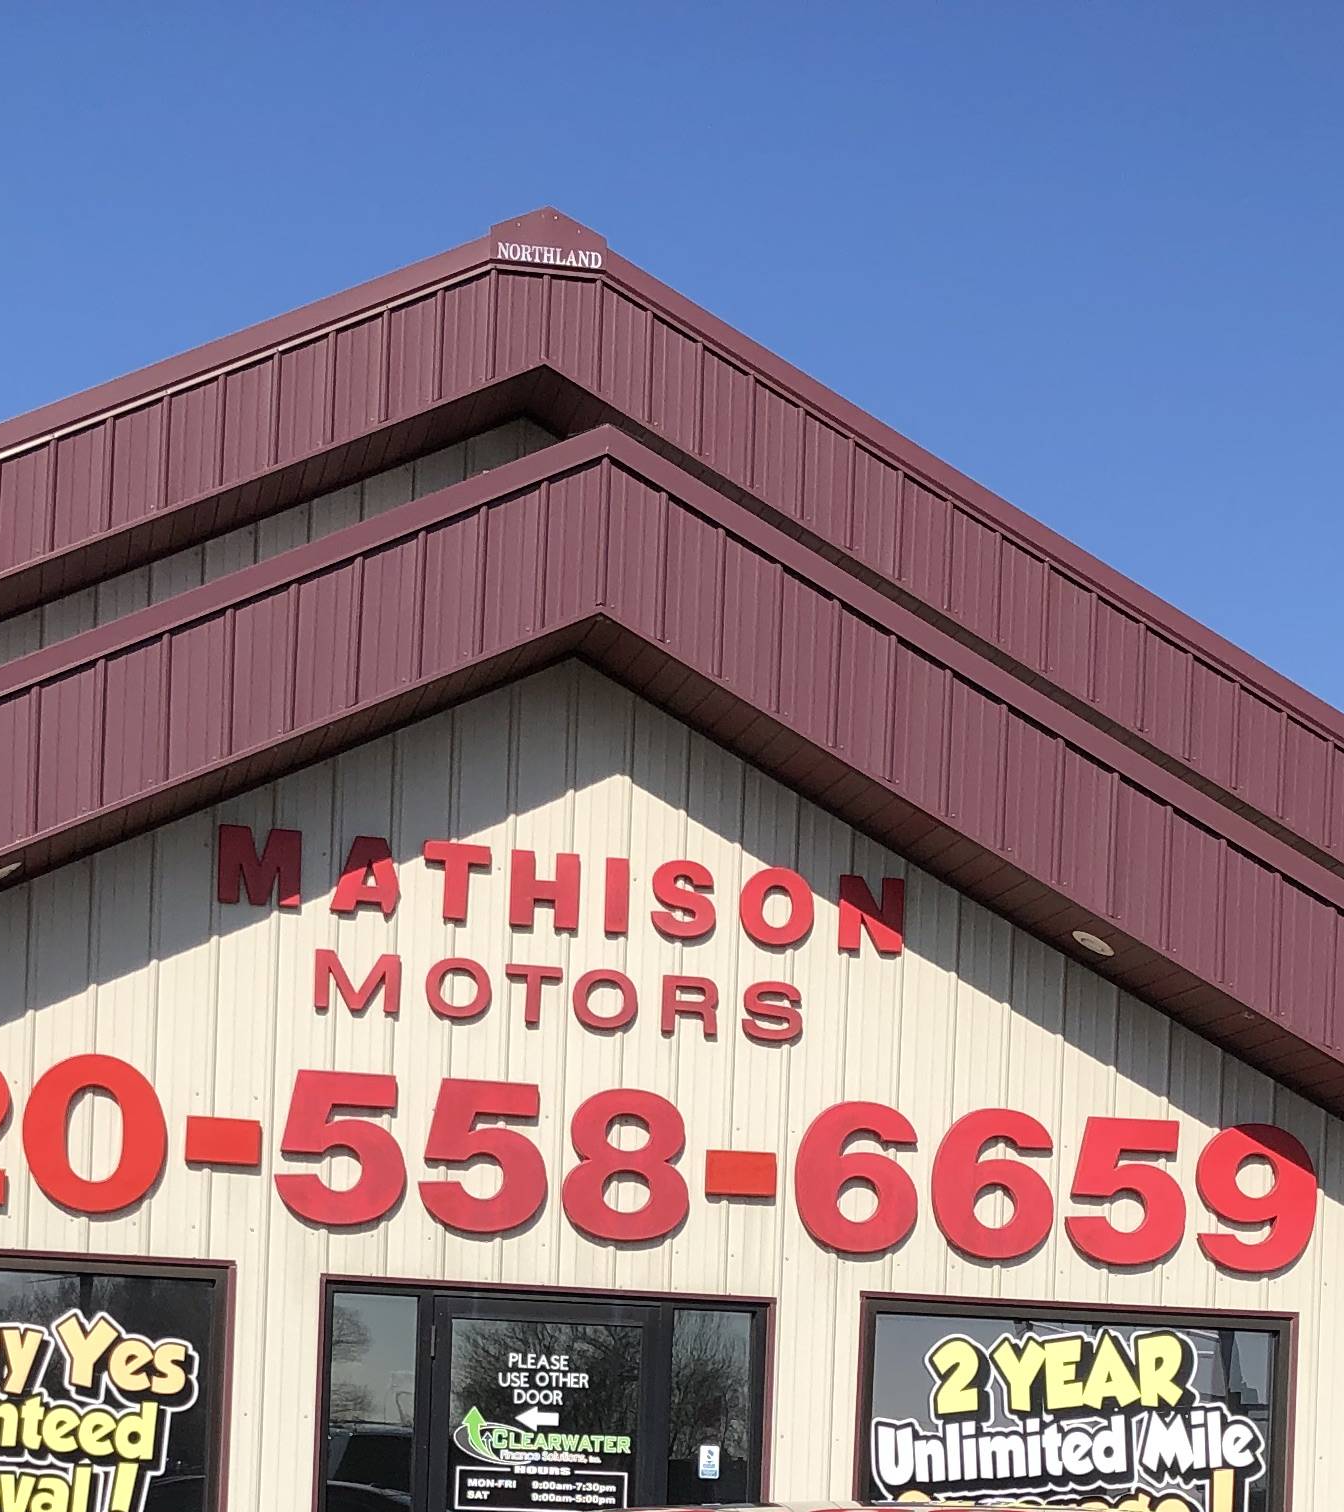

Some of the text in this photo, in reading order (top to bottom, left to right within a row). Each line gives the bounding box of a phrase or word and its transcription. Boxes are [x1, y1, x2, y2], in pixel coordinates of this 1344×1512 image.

[496, 242, 602, 269] NORTHLAND
[218, 824, 904, 956] MATHISON
[314, 948, 803, 1042] MOTORS
[54, 1312, 188, 1397] Yes
[508, 1352, 570, 1371] PLEASE
[498, 1371, 590, 1389] USE OTHER
[930, 1334, 1186, 1415] 2 YEAR
[513, 1388, 564, 1406] DOOR
[491, 1429, 632, 1455] CLEARWATER
[876, 1406, 1256, 1486] Unlimited Mile
[466, 1478, 517, 1490] MON-FRI
[466, 1490, 490, 1501] SAT
